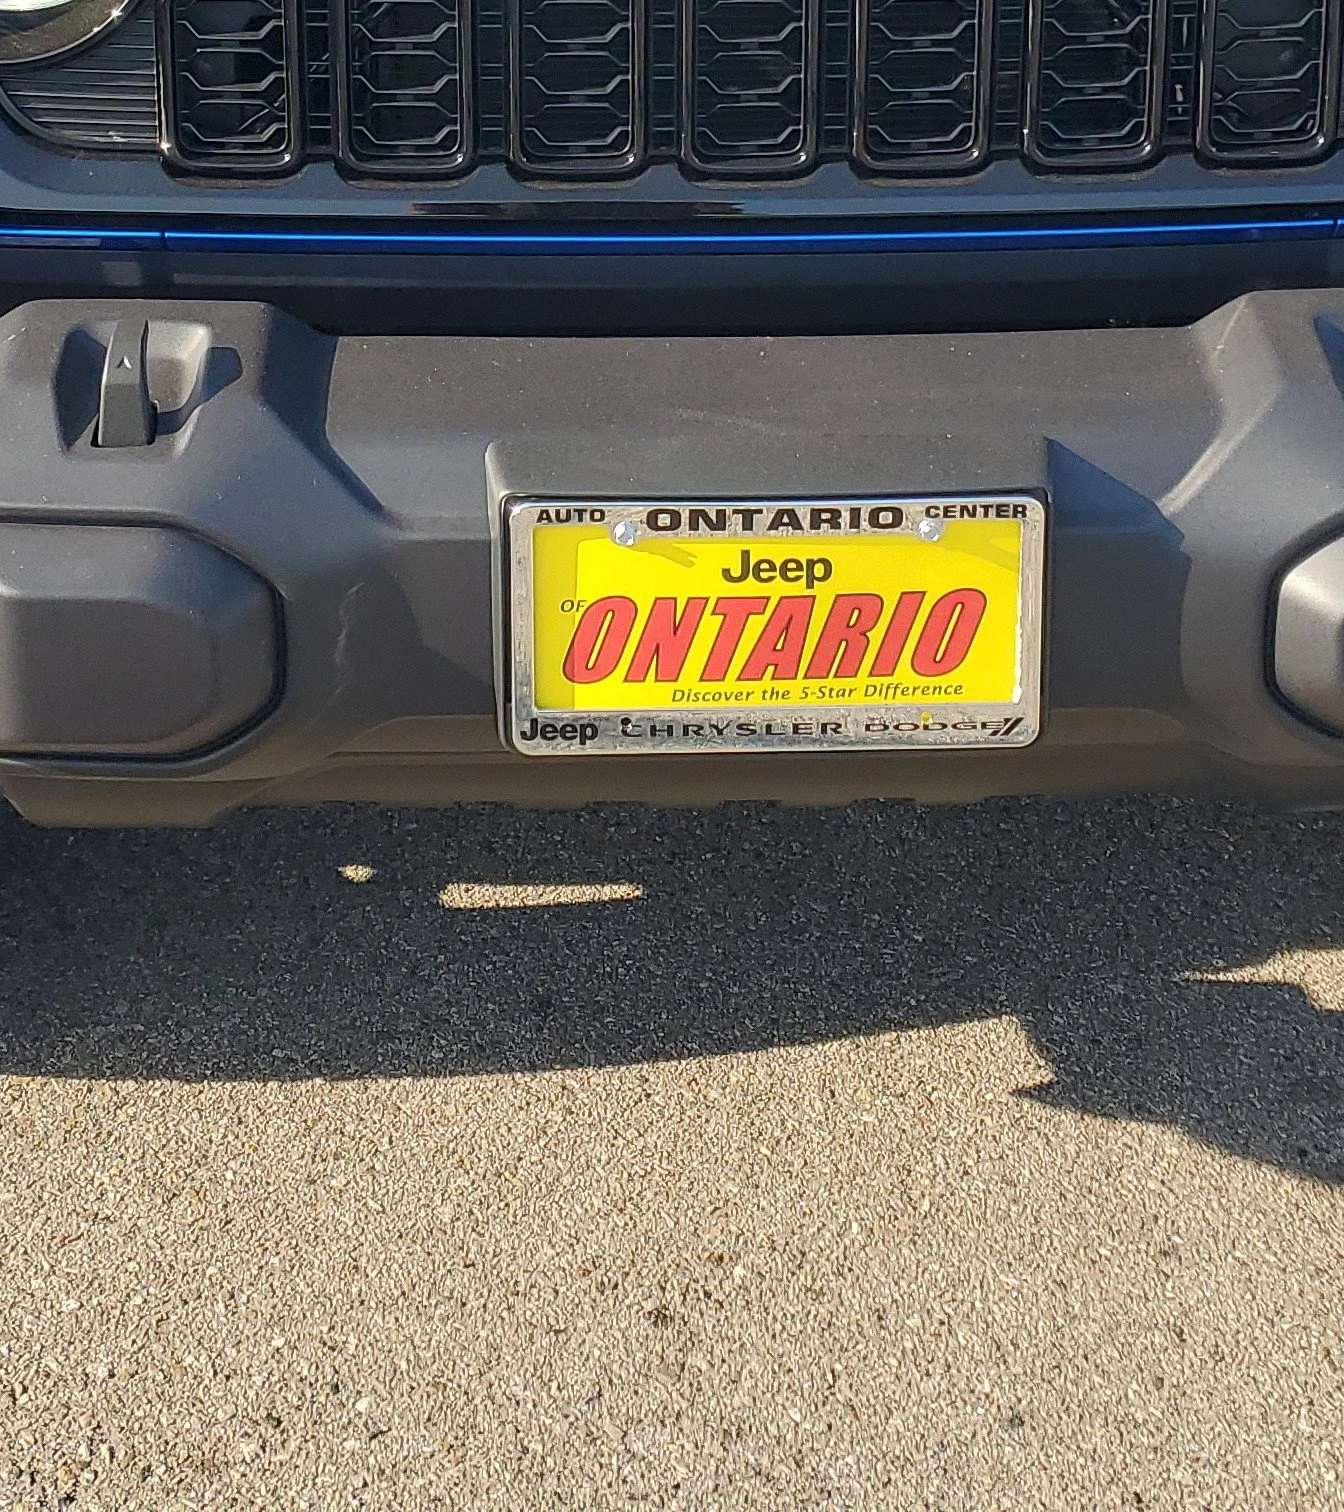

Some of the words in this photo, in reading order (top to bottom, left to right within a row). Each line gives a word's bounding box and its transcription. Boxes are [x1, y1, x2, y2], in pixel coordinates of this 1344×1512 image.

[535, 508, 606, 524] AUTO
[645, 506, 904, 532] ONTARIO
[924, 503, 1028, 519] CENTER
[721, 549, 833, 590] Jeep
[560, 598, 586, 614] OF
[562, 588, 988, 685] ONTARIO
[671, 687, 754, 703] Discover
[761, 686, 791, 702] the
[799, 685, 857, 700] 5-Star
[864, 682, 964, 700] Difference
[519, 717, 600, 746] Jeep
[620, 721, 843, 738] CHRYSLER
[864, 720, 1004, 733] DODGE
